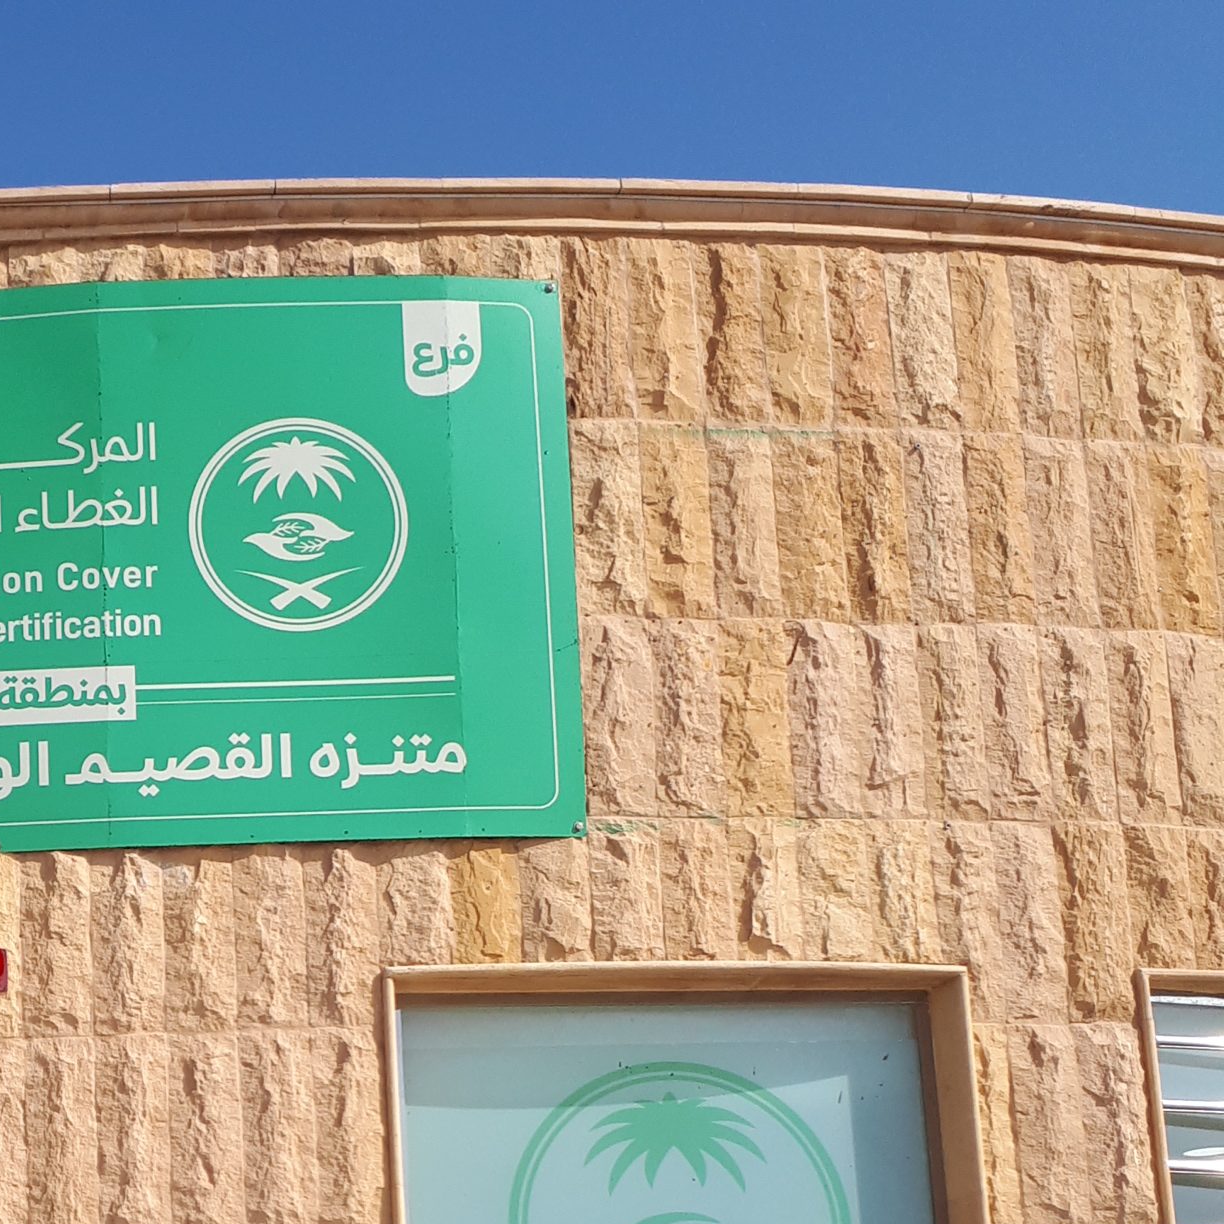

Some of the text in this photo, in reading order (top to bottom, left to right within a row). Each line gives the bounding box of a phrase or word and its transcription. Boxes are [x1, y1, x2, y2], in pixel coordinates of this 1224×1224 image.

[411, 332, 475, 378] فرع
[14, 484, 159, 535] الغطاء
[56, 561, 159, 590] Cover
[64, 732, 293, 798] القصيم
[308, 731, 468, 790] متنزه
